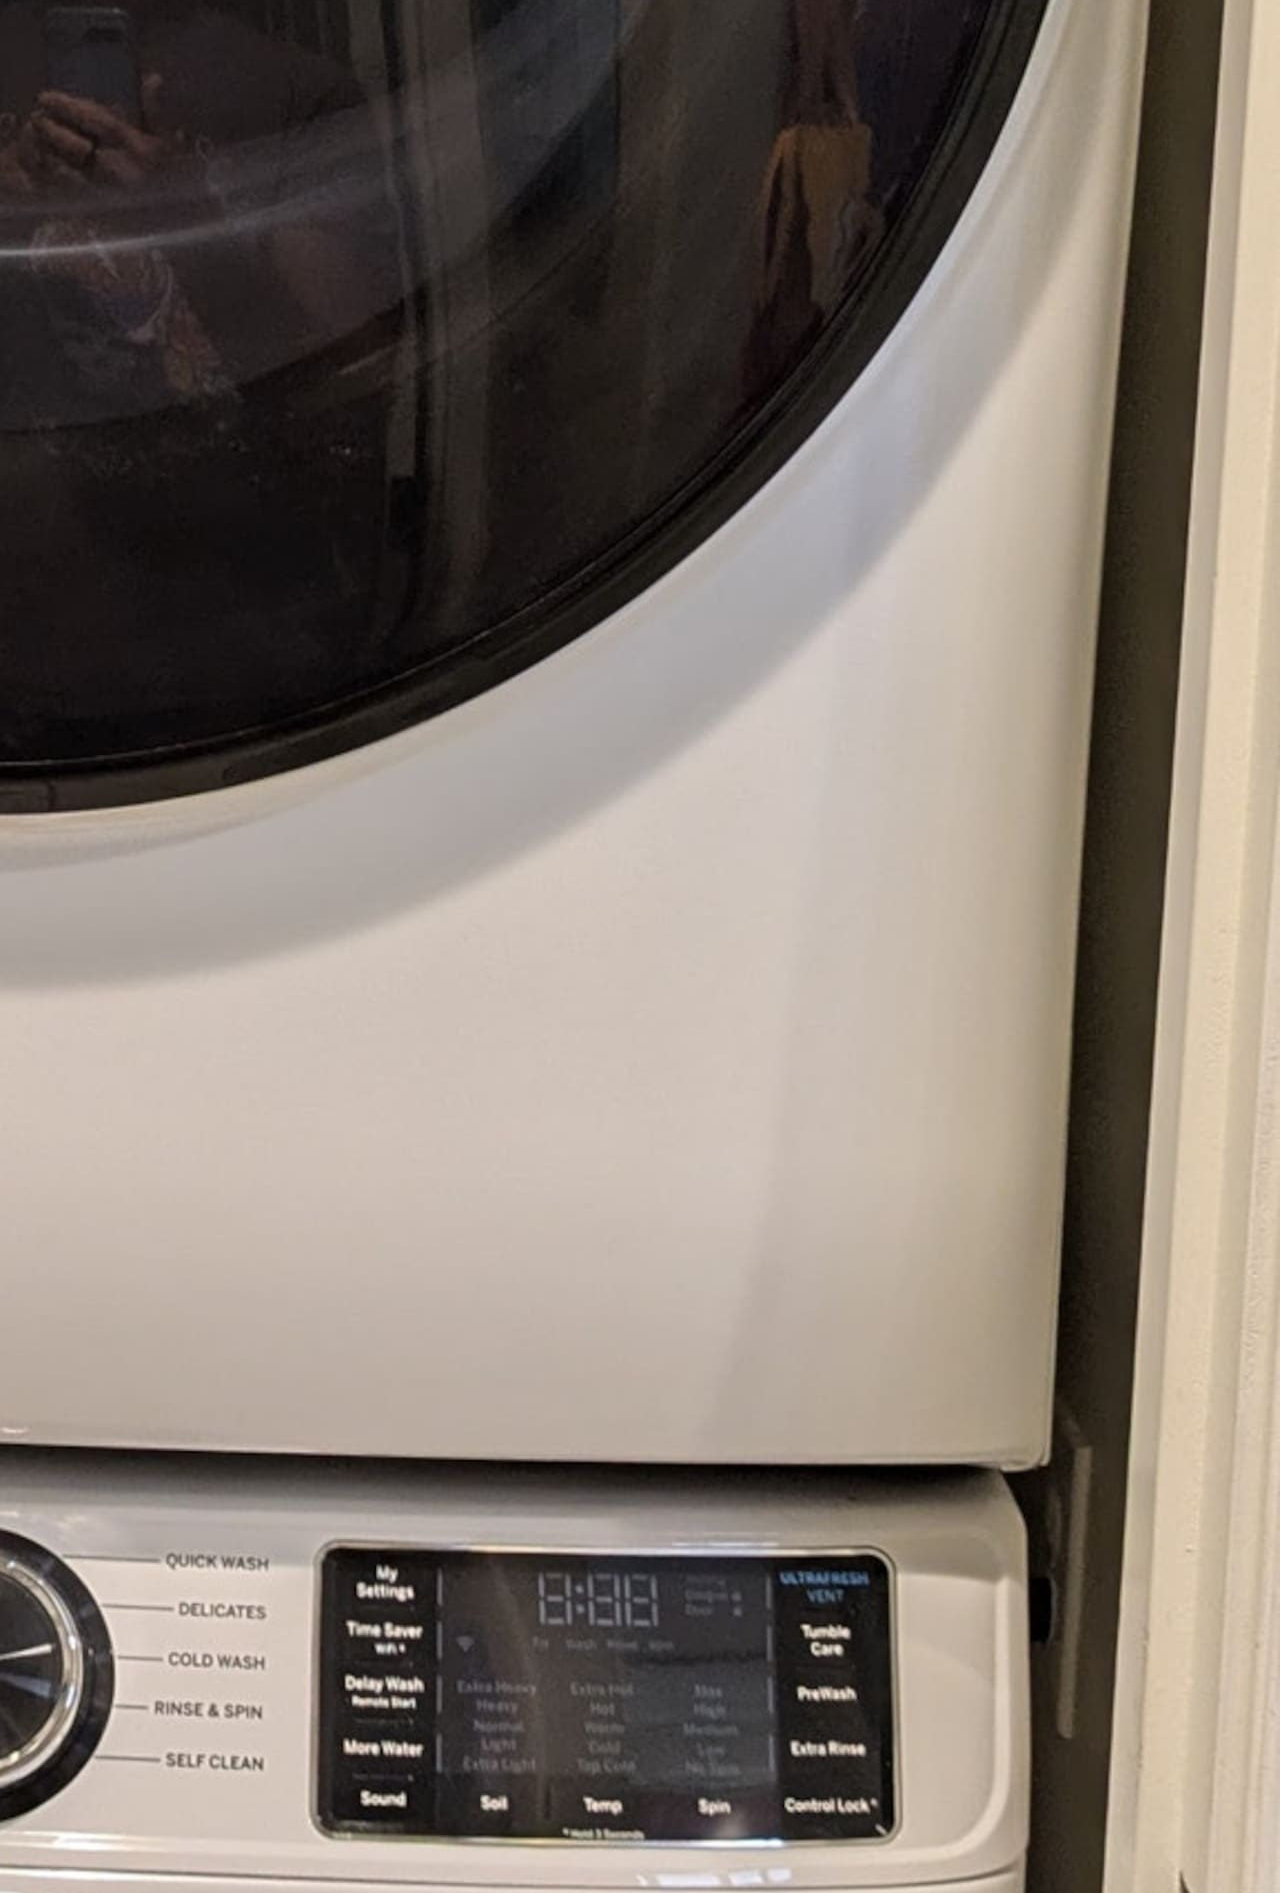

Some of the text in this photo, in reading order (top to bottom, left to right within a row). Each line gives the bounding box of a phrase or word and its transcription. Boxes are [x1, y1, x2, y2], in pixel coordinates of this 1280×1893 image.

[166, 1553, 270, 1571] QUICK WASH
[376, 1564, 398, 1583] My
[779, 1570, 870, 1586] ULTRAFRESH
[356, 1582, 415, 1601] Settings
[807, 1589, 844, 1604] VENT
[178, 1602, 267, 1620] DELICATES
[346, 1620, 423, 1639] Time Saver
[800, 1623, 852, 1639] Tumble
[810, 1641, 843, 1657] Care
[168, 1652, 266, 1671] COLD WASH
[344, 1675, 425, 1694] Delay Wash
[796, 1685, 858, 1702] PreWash
[154, 1701, 263, 1720] RINSE & SPIN
[343, 1738, 424, 1757] More Water
[790, 1740, 866, 1757] Extra Rinse
[165, 1753, 264, 1772] SELF CLEAN
[360, 1790, 408, 1807] Sound
[480, 1795, 509, 1811] Soil
[583, 1795, 623, 1816] Temp
[698, 1797, 732, 1816] Spin
[784, 1797, 835, 1814] Control
